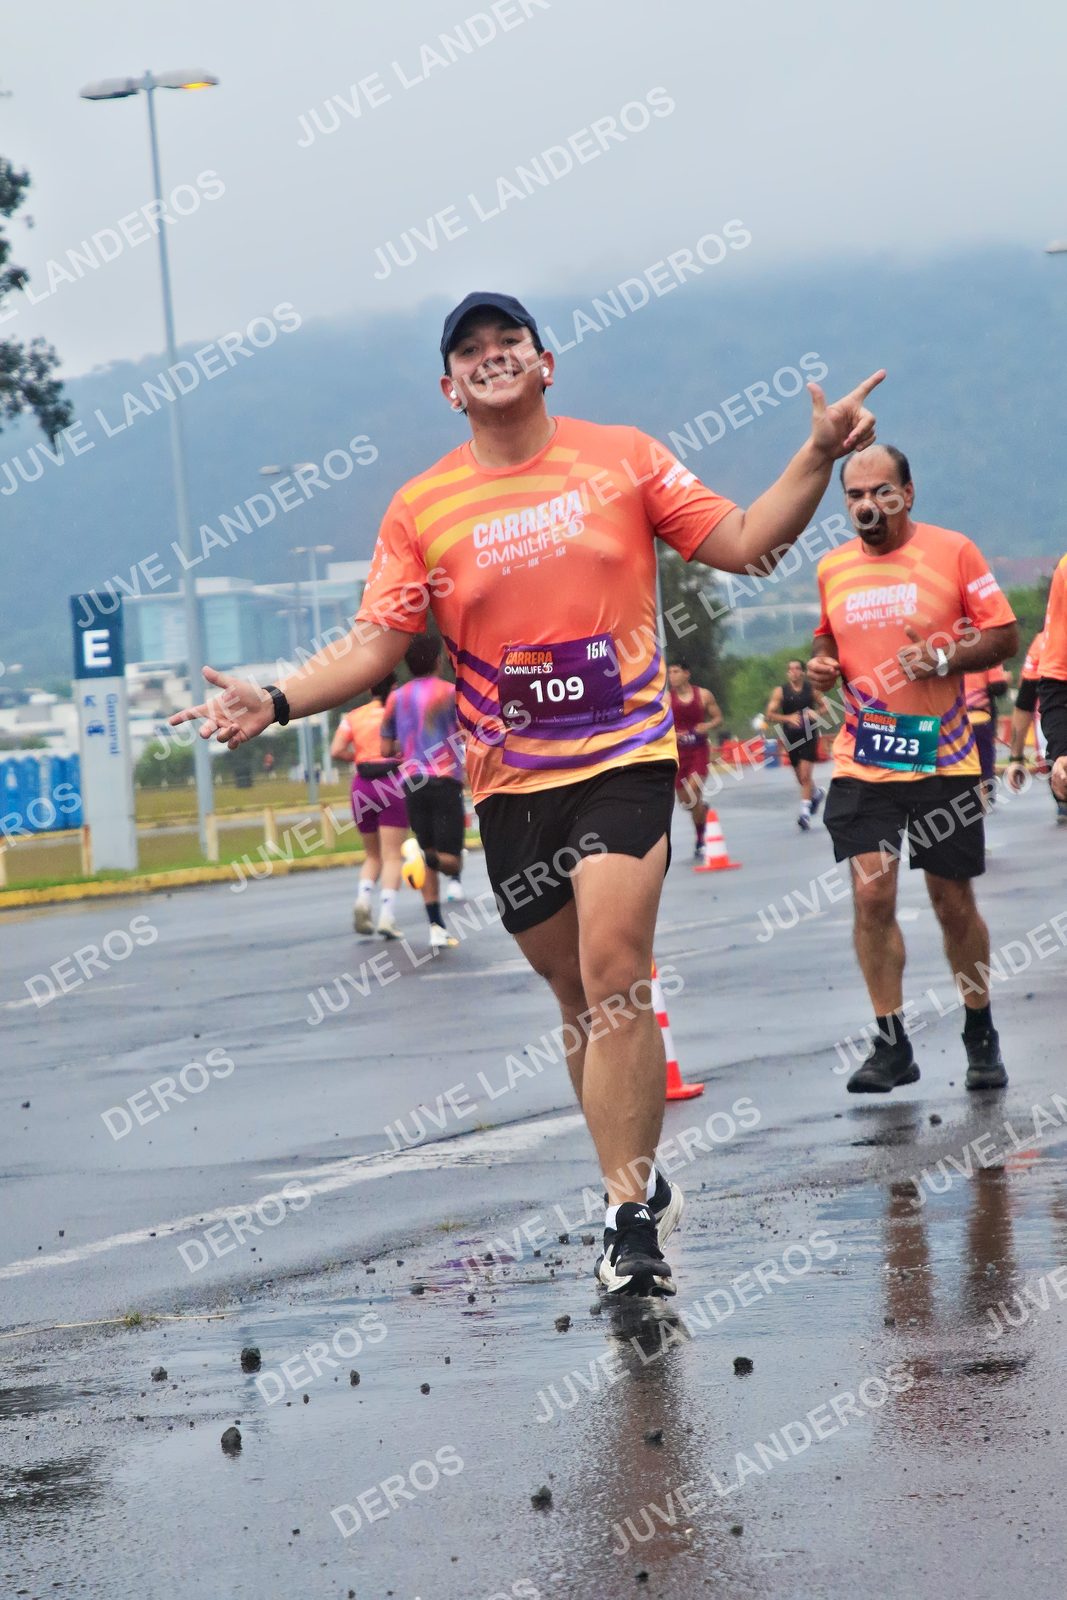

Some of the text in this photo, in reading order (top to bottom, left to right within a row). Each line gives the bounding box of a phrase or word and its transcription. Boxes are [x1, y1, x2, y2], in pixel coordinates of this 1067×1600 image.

[473, 490, 582, 548] CARRERA
[846, 582, 917, 611] CARRERA
[83, 629, 112, 668] E
[505, 651, 553, 665] CARRERA
[529, 676, 585, 703] 109
[872, 734, 920, 756] 1723
